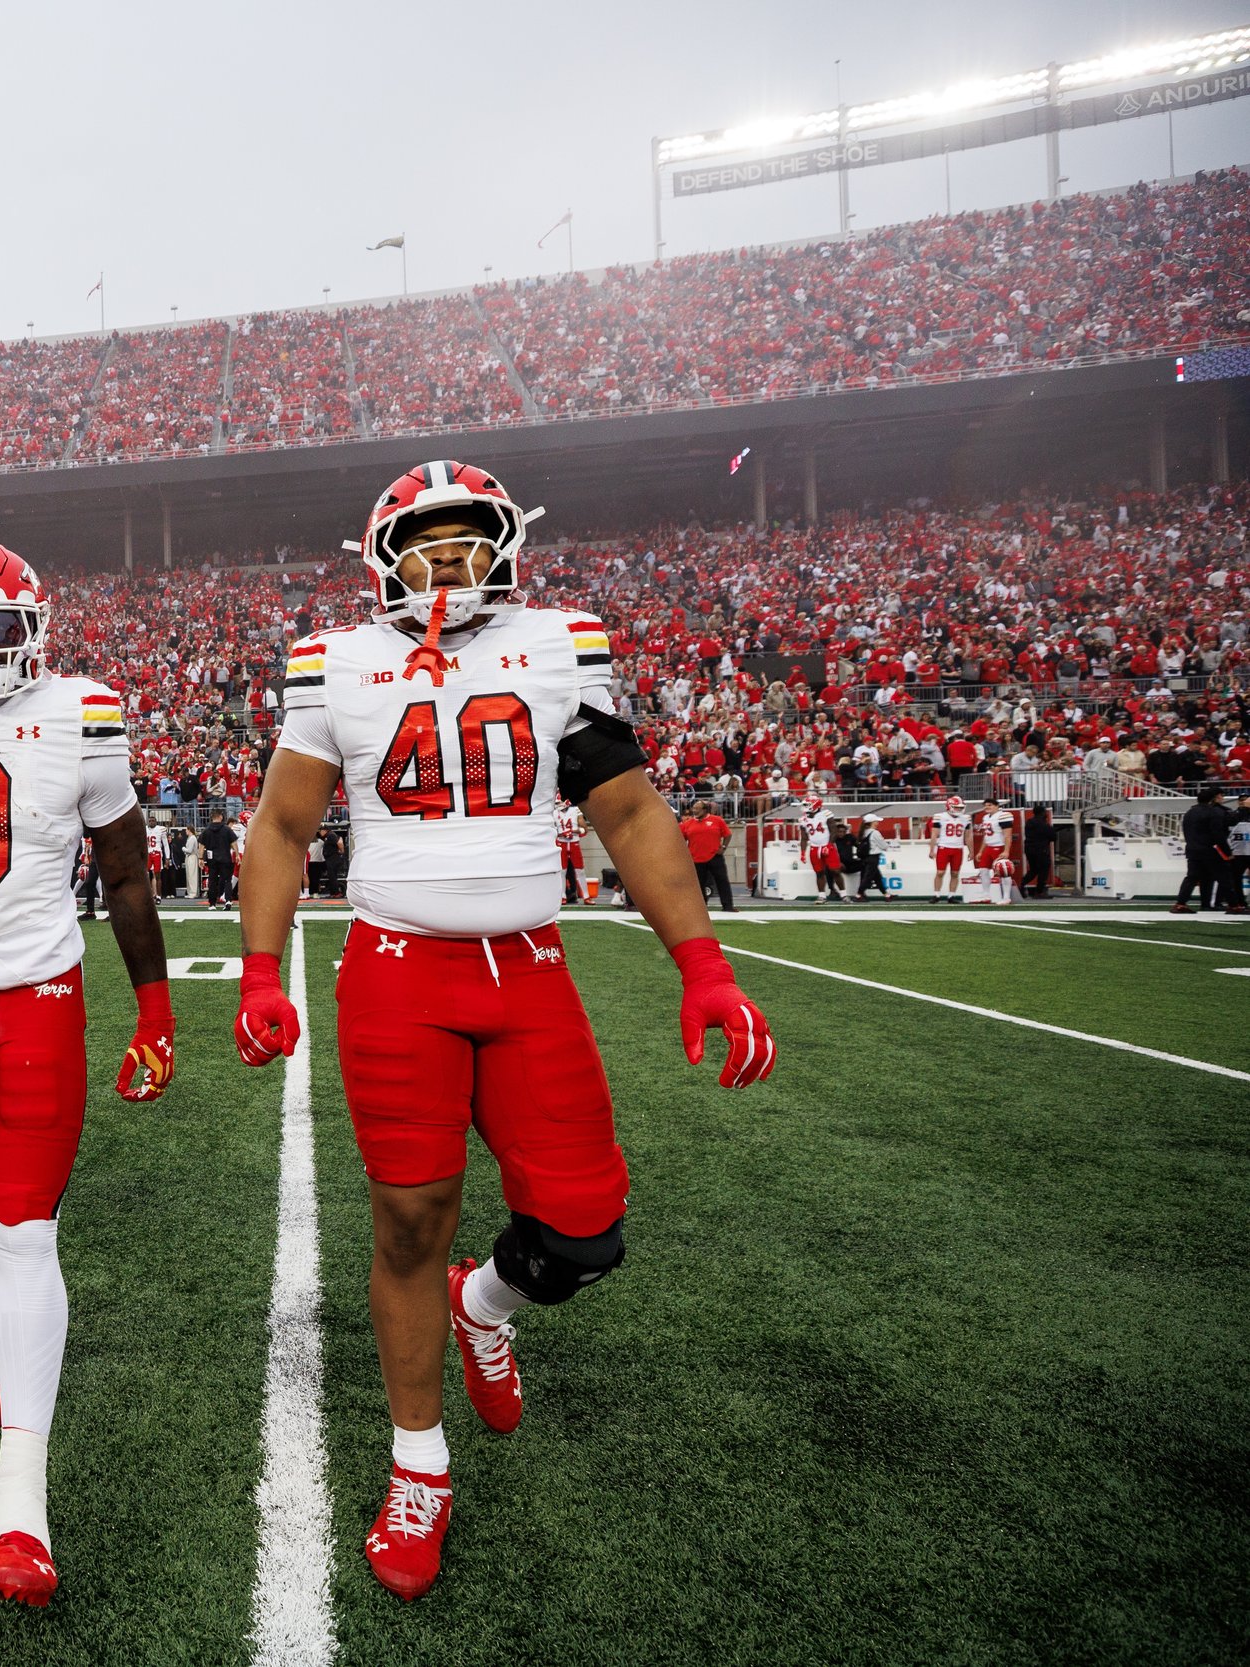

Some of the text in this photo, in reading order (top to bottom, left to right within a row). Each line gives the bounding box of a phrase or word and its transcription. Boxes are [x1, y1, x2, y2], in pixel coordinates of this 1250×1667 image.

[681, 165, 763, 191] DEFEND
[766, 155, 808, 177] THE
[375, 691, 539, 821] 40
[945, 823, 963, 837] 86
[34, 983, 73, 998] Terps
